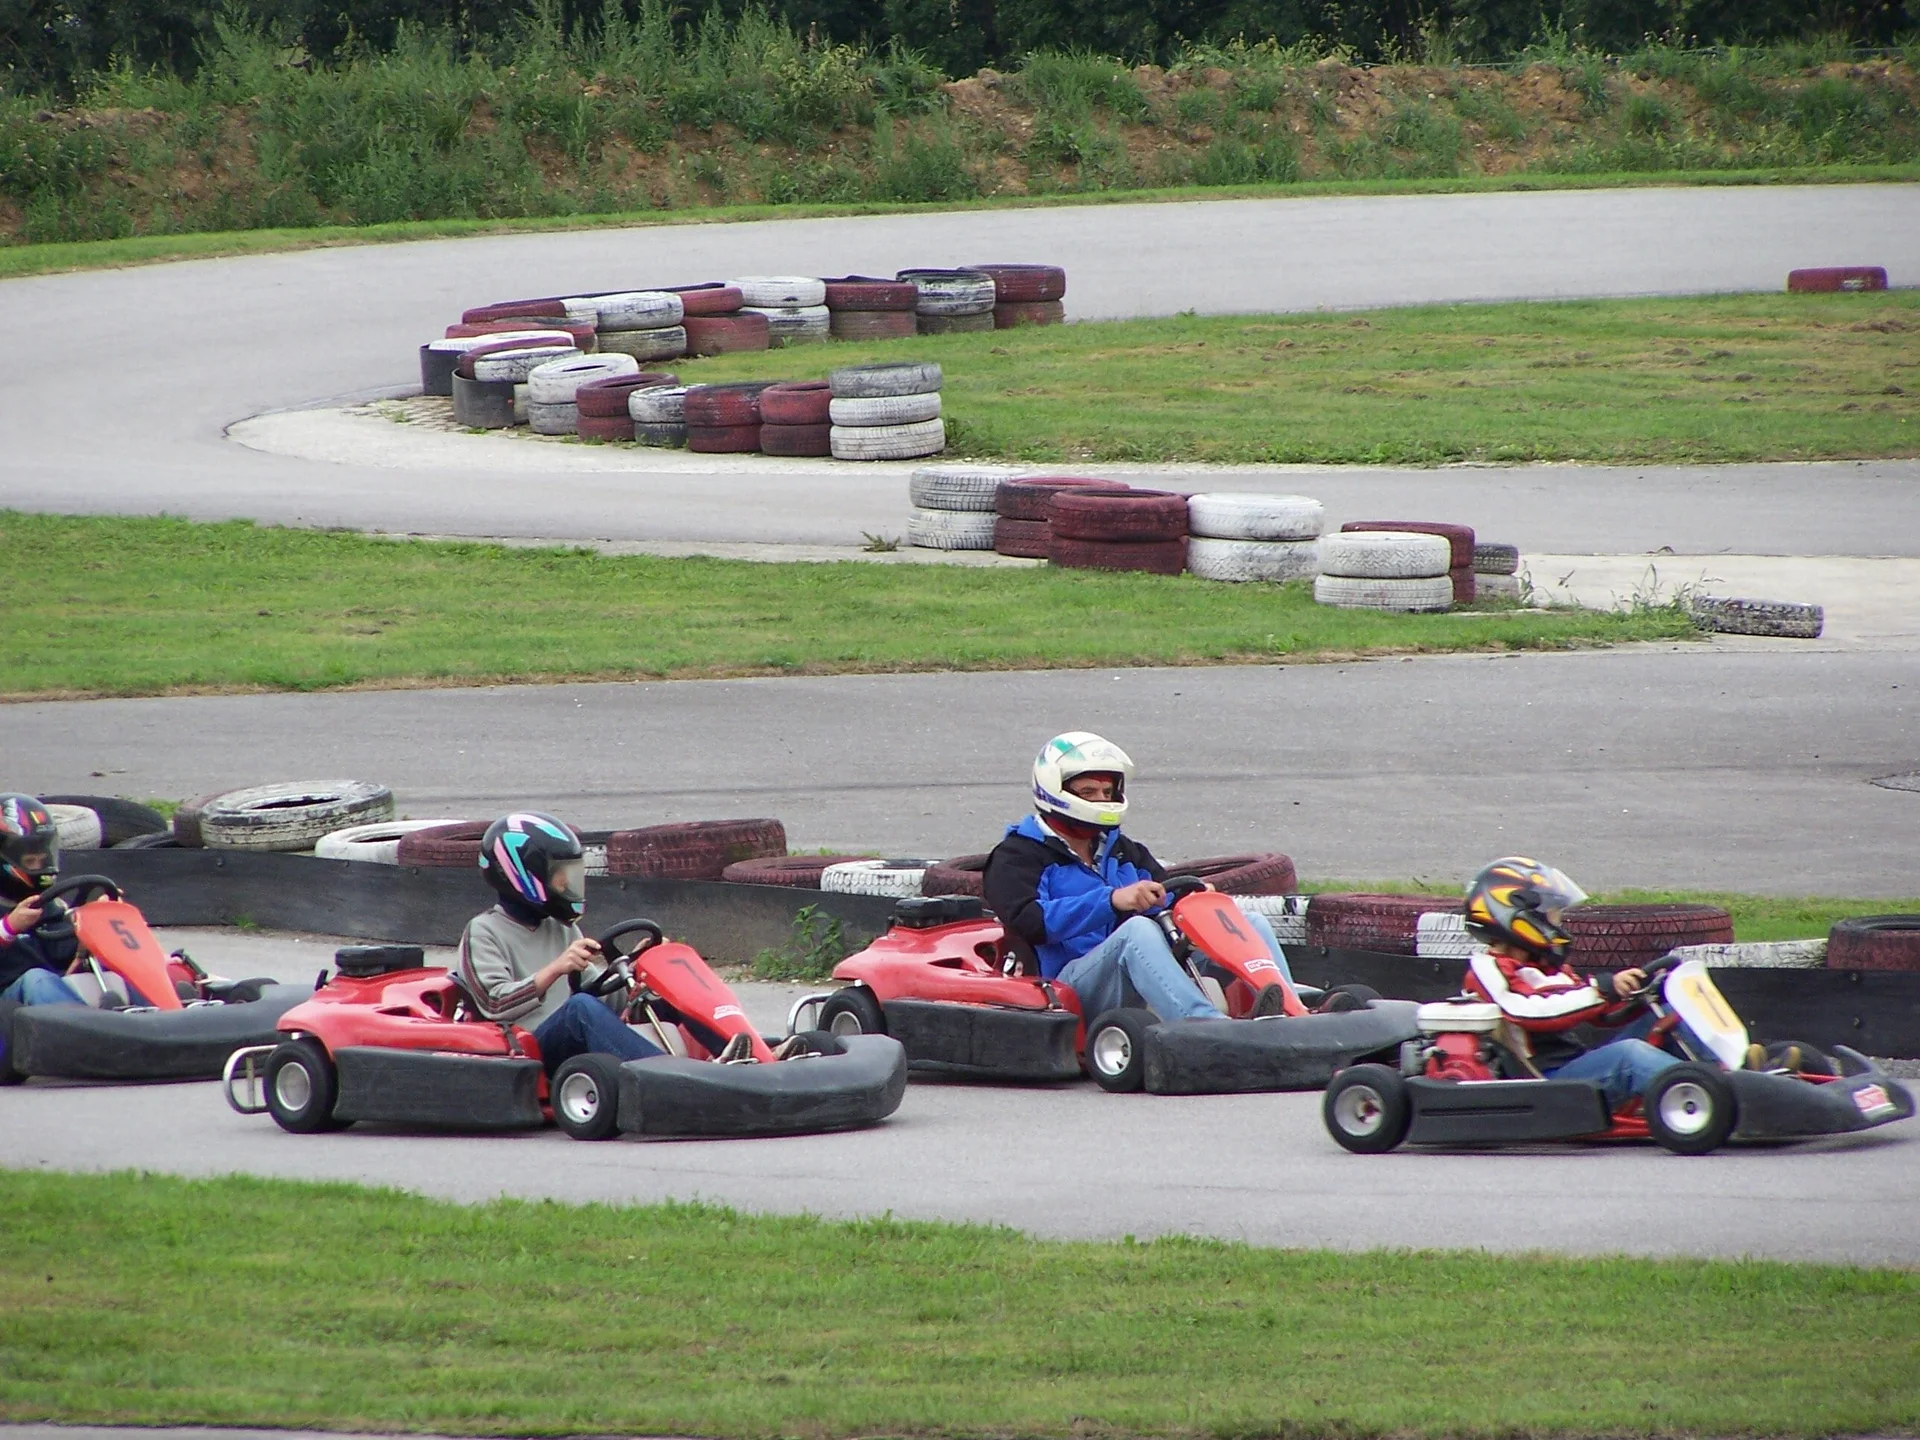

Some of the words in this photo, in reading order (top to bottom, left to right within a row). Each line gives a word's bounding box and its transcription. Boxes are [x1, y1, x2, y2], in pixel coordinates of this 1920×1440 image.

[109, 918, 141, 951] 5
[1214, 908, 1248, 942] 4
[667, 957, 713, 992] 7
